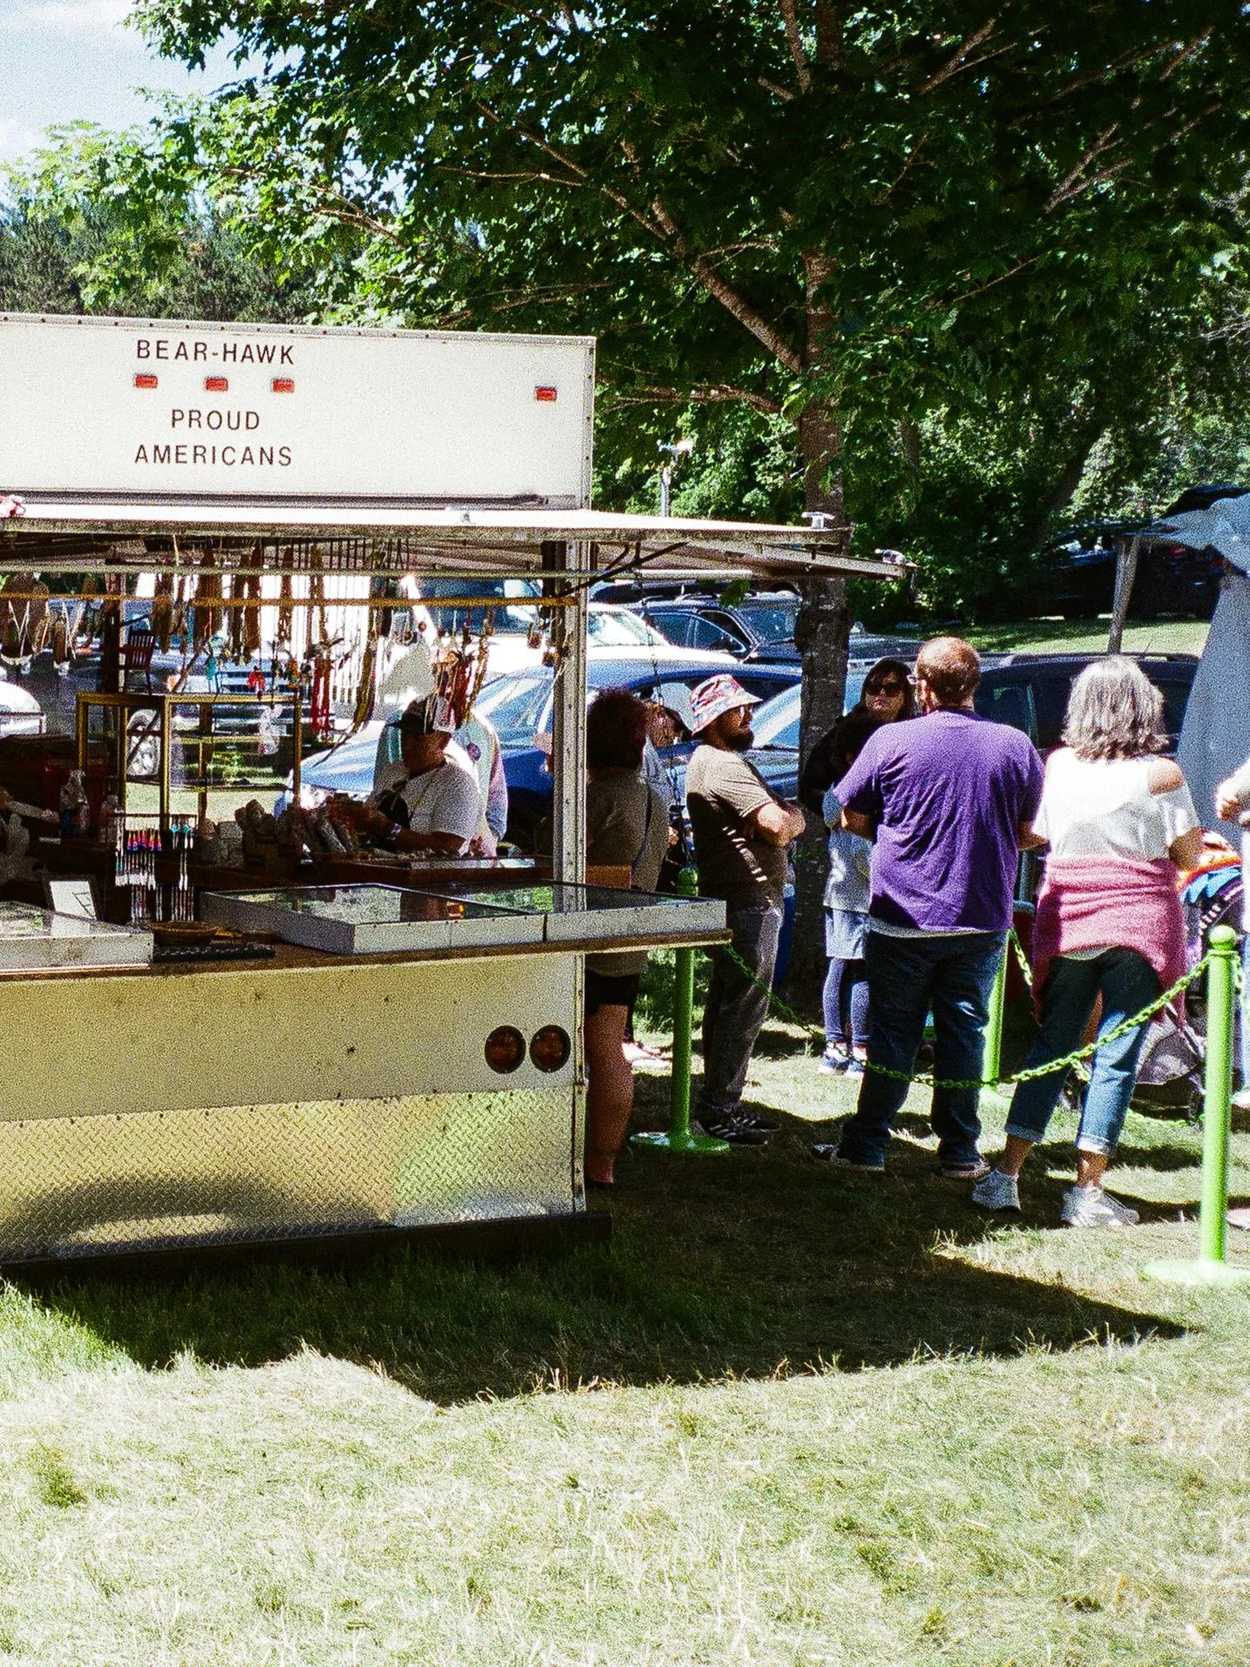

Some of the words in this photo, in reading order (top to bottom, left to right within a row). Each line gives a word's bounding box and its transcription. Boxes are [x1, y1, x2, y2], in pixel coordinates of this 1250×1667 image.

[136, 339, 294, 365] BEAR-HAWK
[171, 408, 260, 431] PROUD
[134, 443, 292, 467] AMERICANS
